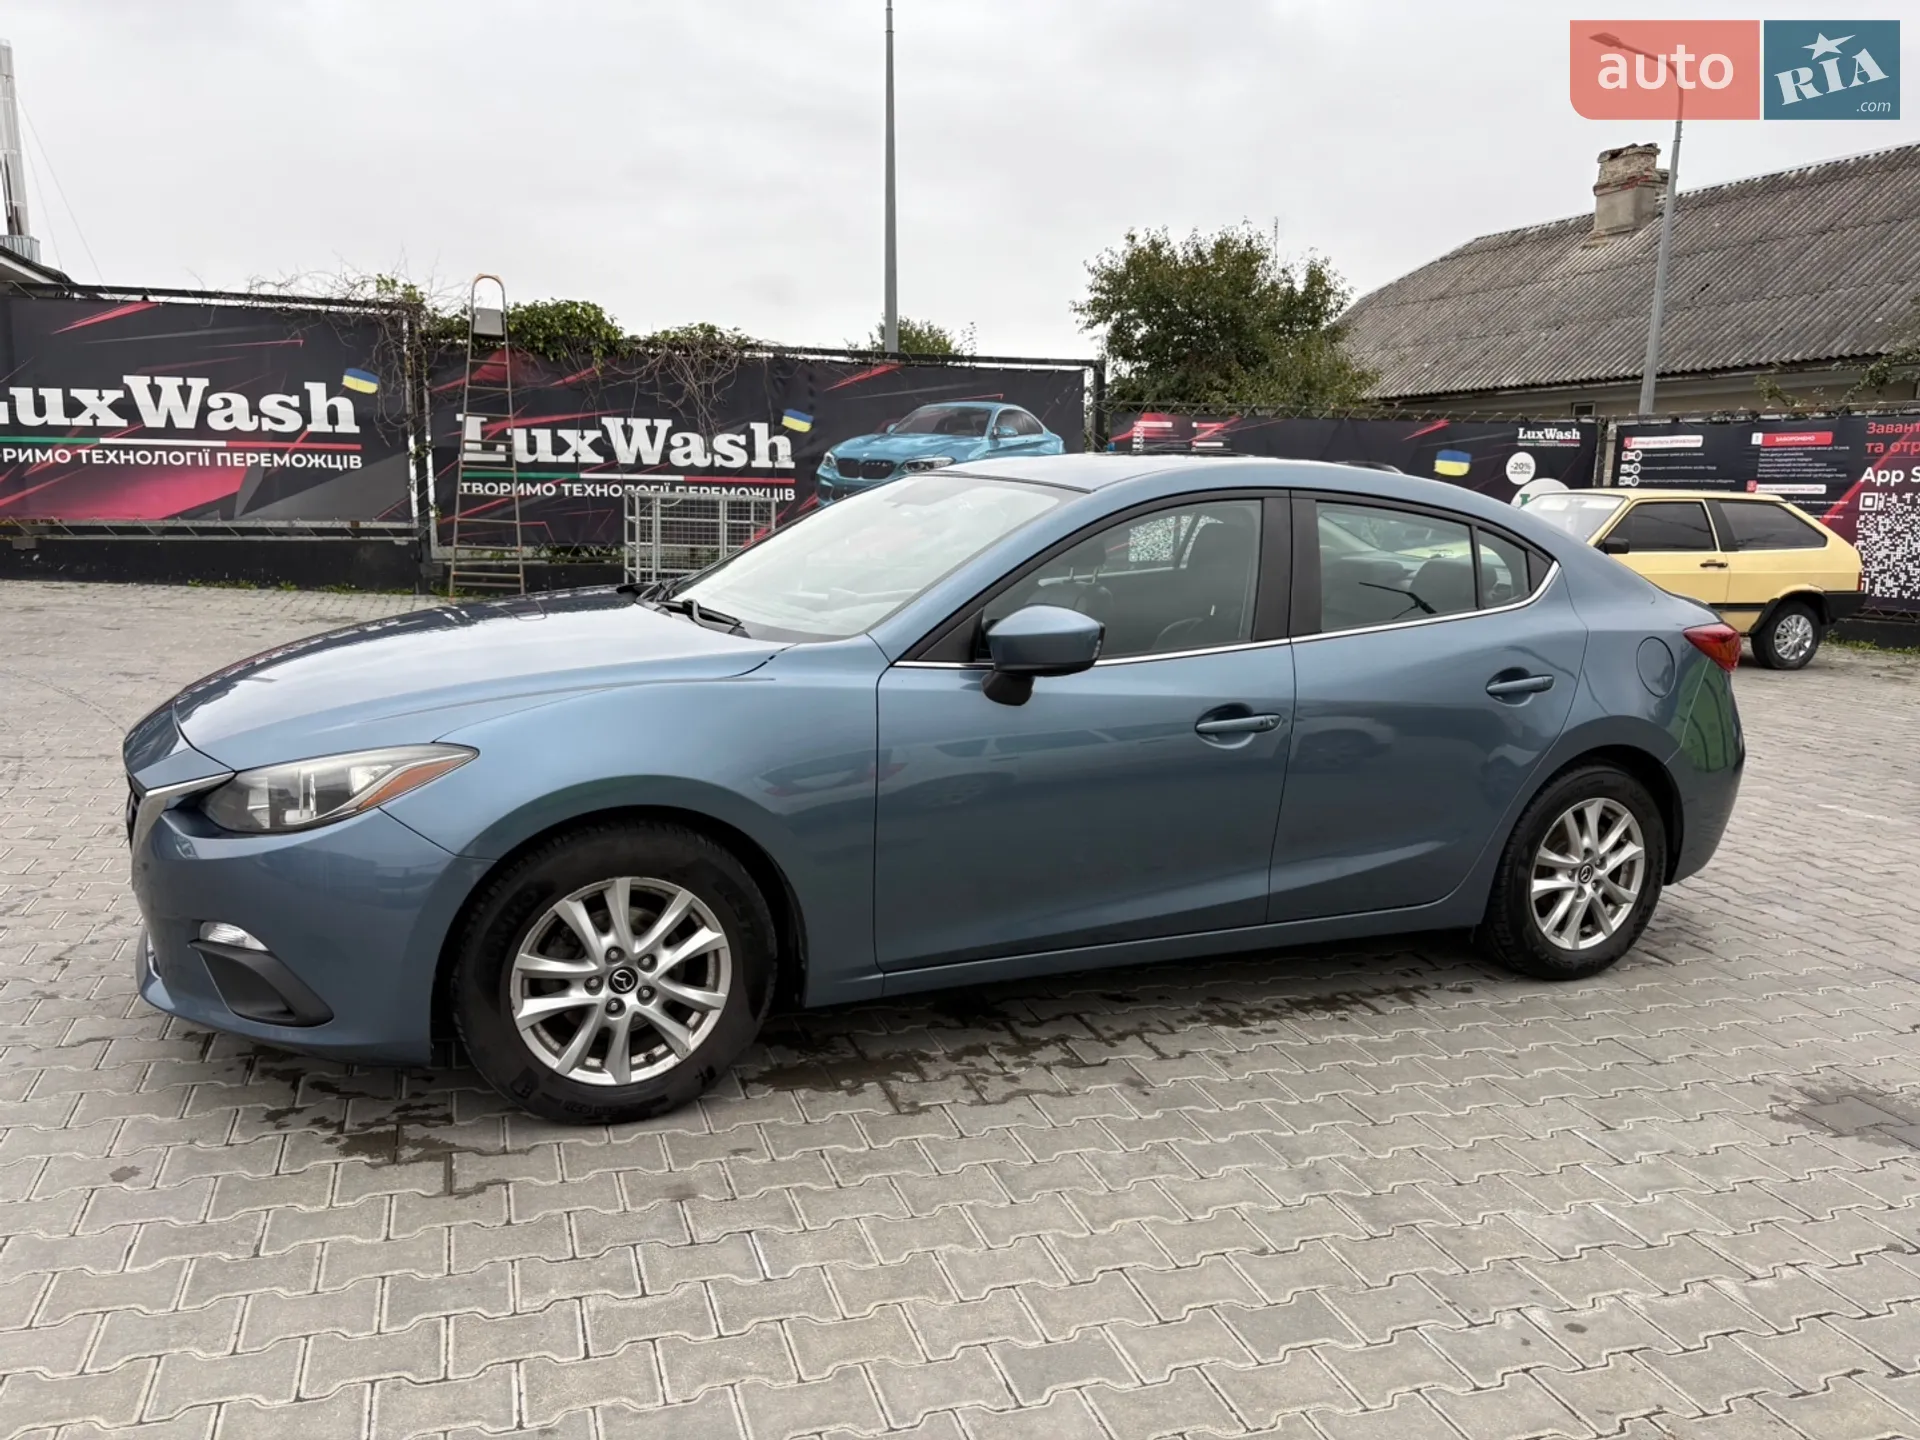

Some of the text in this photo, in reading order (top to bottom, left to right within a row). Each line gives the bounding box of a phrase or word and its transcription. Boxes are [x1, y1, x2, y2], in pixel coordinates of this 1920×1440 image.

[456, 413, 796, 469] LuxWash
[1517, 427, 1581, 440] LuxWash
[1865, 442, 1884, 453] та
[0, 447, 362, 470] РИМО ТЕХНОЛОГІЇ ПЕРЕМОЖЦІВ
[1860, 466, 1905, 487] App
[461, 482, 556, 497] ТВОРИМО
